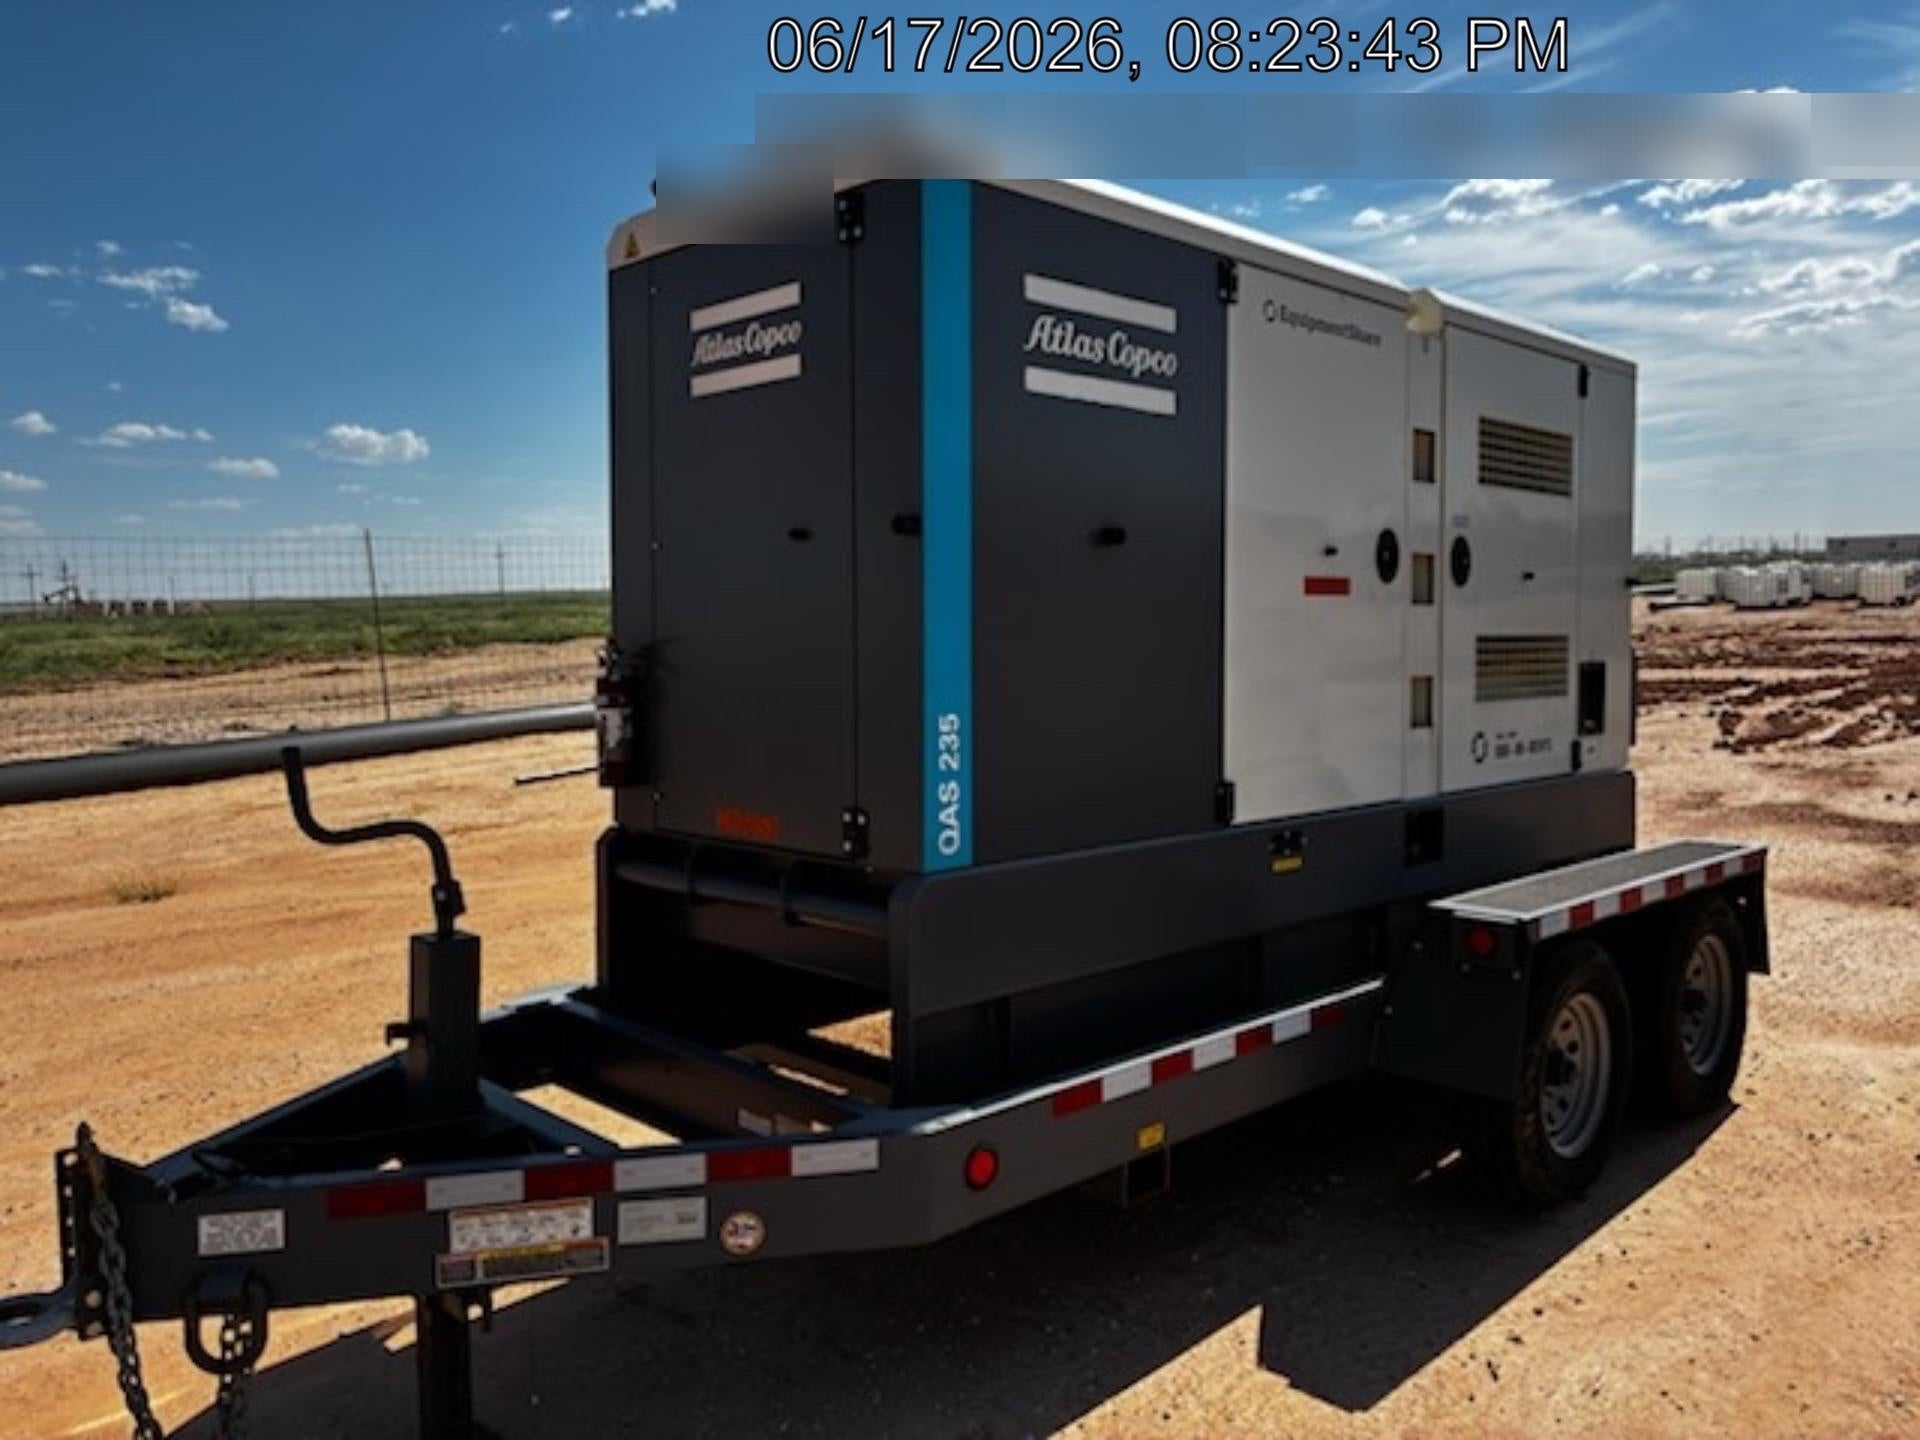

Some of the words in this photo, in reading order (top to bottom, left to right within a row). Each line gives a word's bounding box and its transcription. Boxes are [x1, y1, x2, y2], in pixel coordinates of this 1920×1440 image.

[690, 332, 743, 367] Atlas
[744, 320, 802, 356] Copco
[1023, 313, 1105, 364] Atlas
[1107, 329, 1178, 379] Copco
[937, 712, 961, 772] 235
[937, 779, 960, 857] QAS
